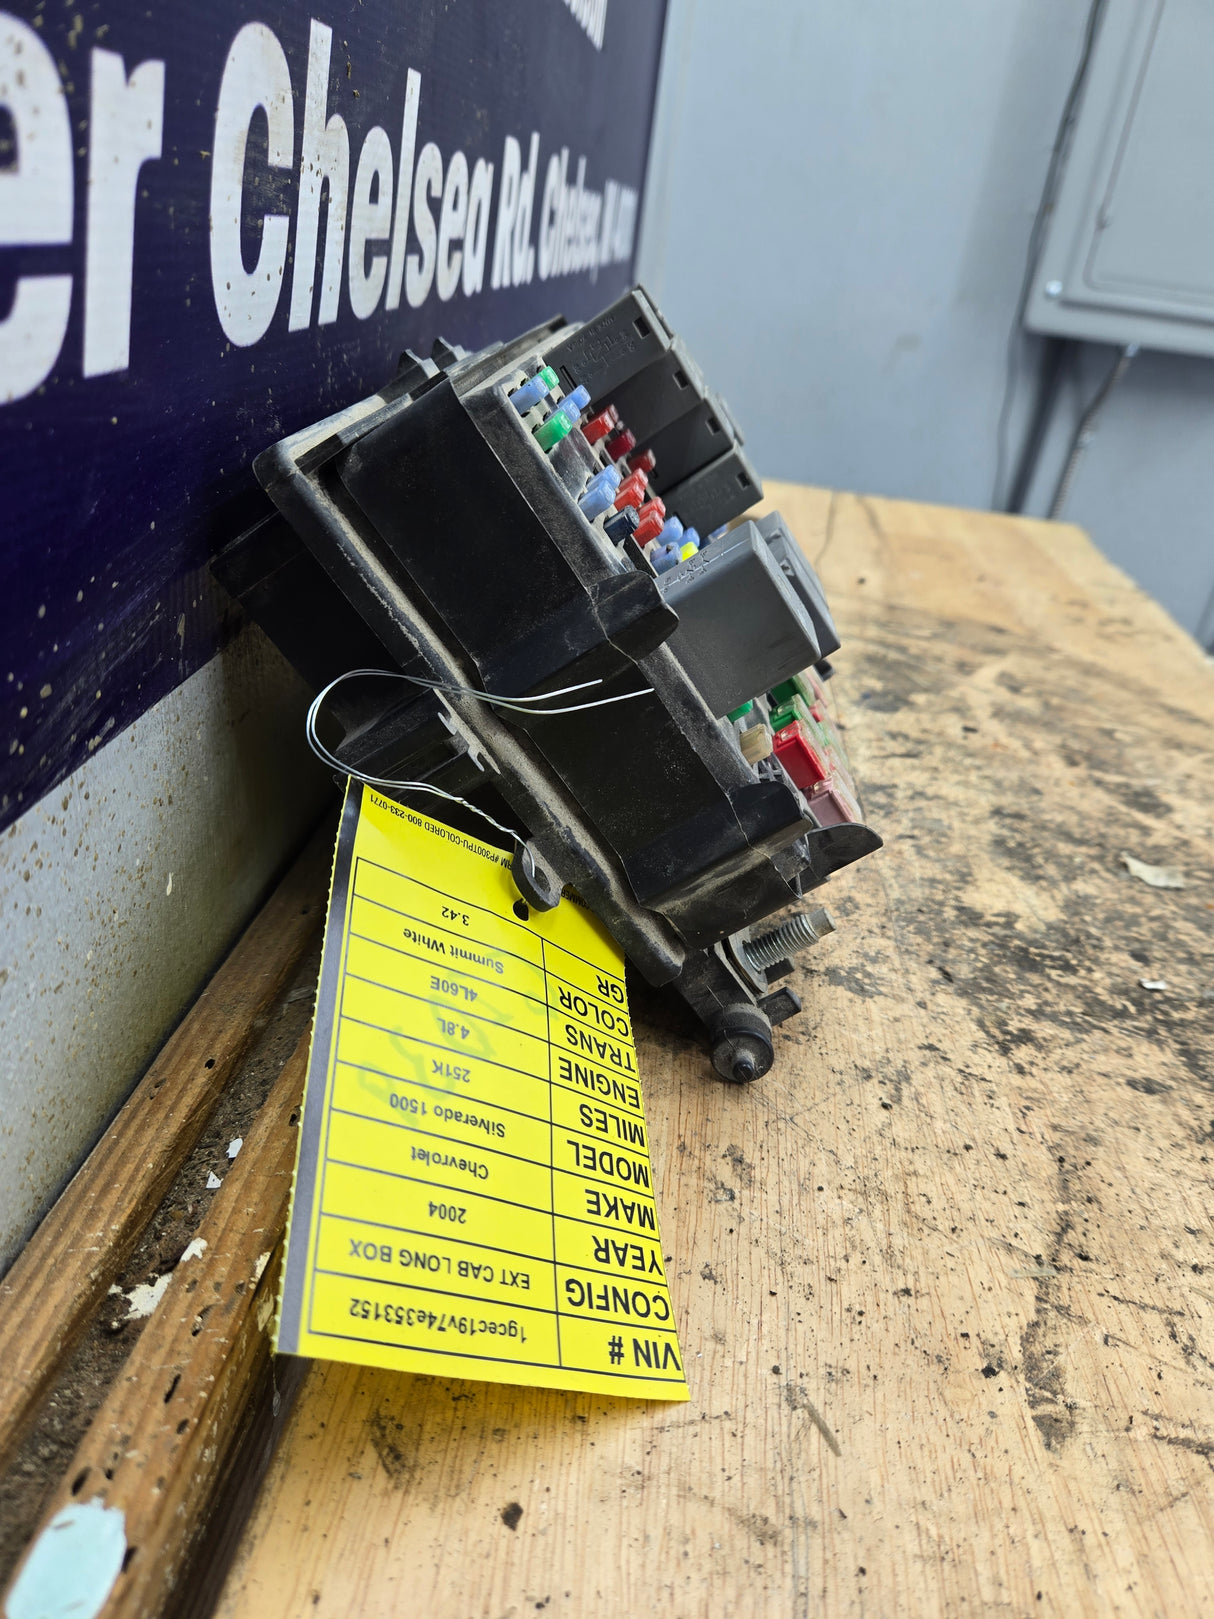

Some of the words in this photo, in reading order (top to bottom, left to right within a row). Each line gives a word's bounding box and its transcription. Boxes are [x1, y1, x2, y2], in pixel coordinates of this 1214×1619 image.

[211, 19, 494, 347] Chelsea
[491, 131, 541, 290] Rd.
[370, 793, 423, 827] 800-233-0771
[442, 906, 469, 926] 3.42
[403, 929, 445, 954] White
[450, 945, 503, 973] Summit
[431, 976, 477, 1001] 4L60E
[595, 974, 624, 1004] GR
[558, 986, 629, 1037] COLOR
[438, 1018, 469, 1039] 4.8L
[565, 1023, 636, 1073] TRANS
[433, 1060, 470, 1082] 251K
[558, 1056, 640, 1109] ENGINE
[390, 1094, 426, 1115] 1500
[434, 1106, 505, 1138] Silverado
[579, 1104, 645, 1147] MILES
[412, 1147, 488, 1179] Chevrolet
[567, 1140, 649, 1188] MODEL
[429, 1201, 466, 1224] 2004
[585, 1189, 655, 1231] MAKE
[349, 1239, 391, 1263] BOX
[399, 1249, 451, 1273] LONG
[592, 1235, 663, 1276] YEAR
[458, 1261, 494, 1282] CAB
[500, 1268, 530, 1290] EXT
[565, 1279, 669, 1321] CONFIG
[350, 1299, 526, 1343] 1gcec19v74e353152
[608, 1335, 624, 1365] #
[633, 1338, 681, 1371] VIN
